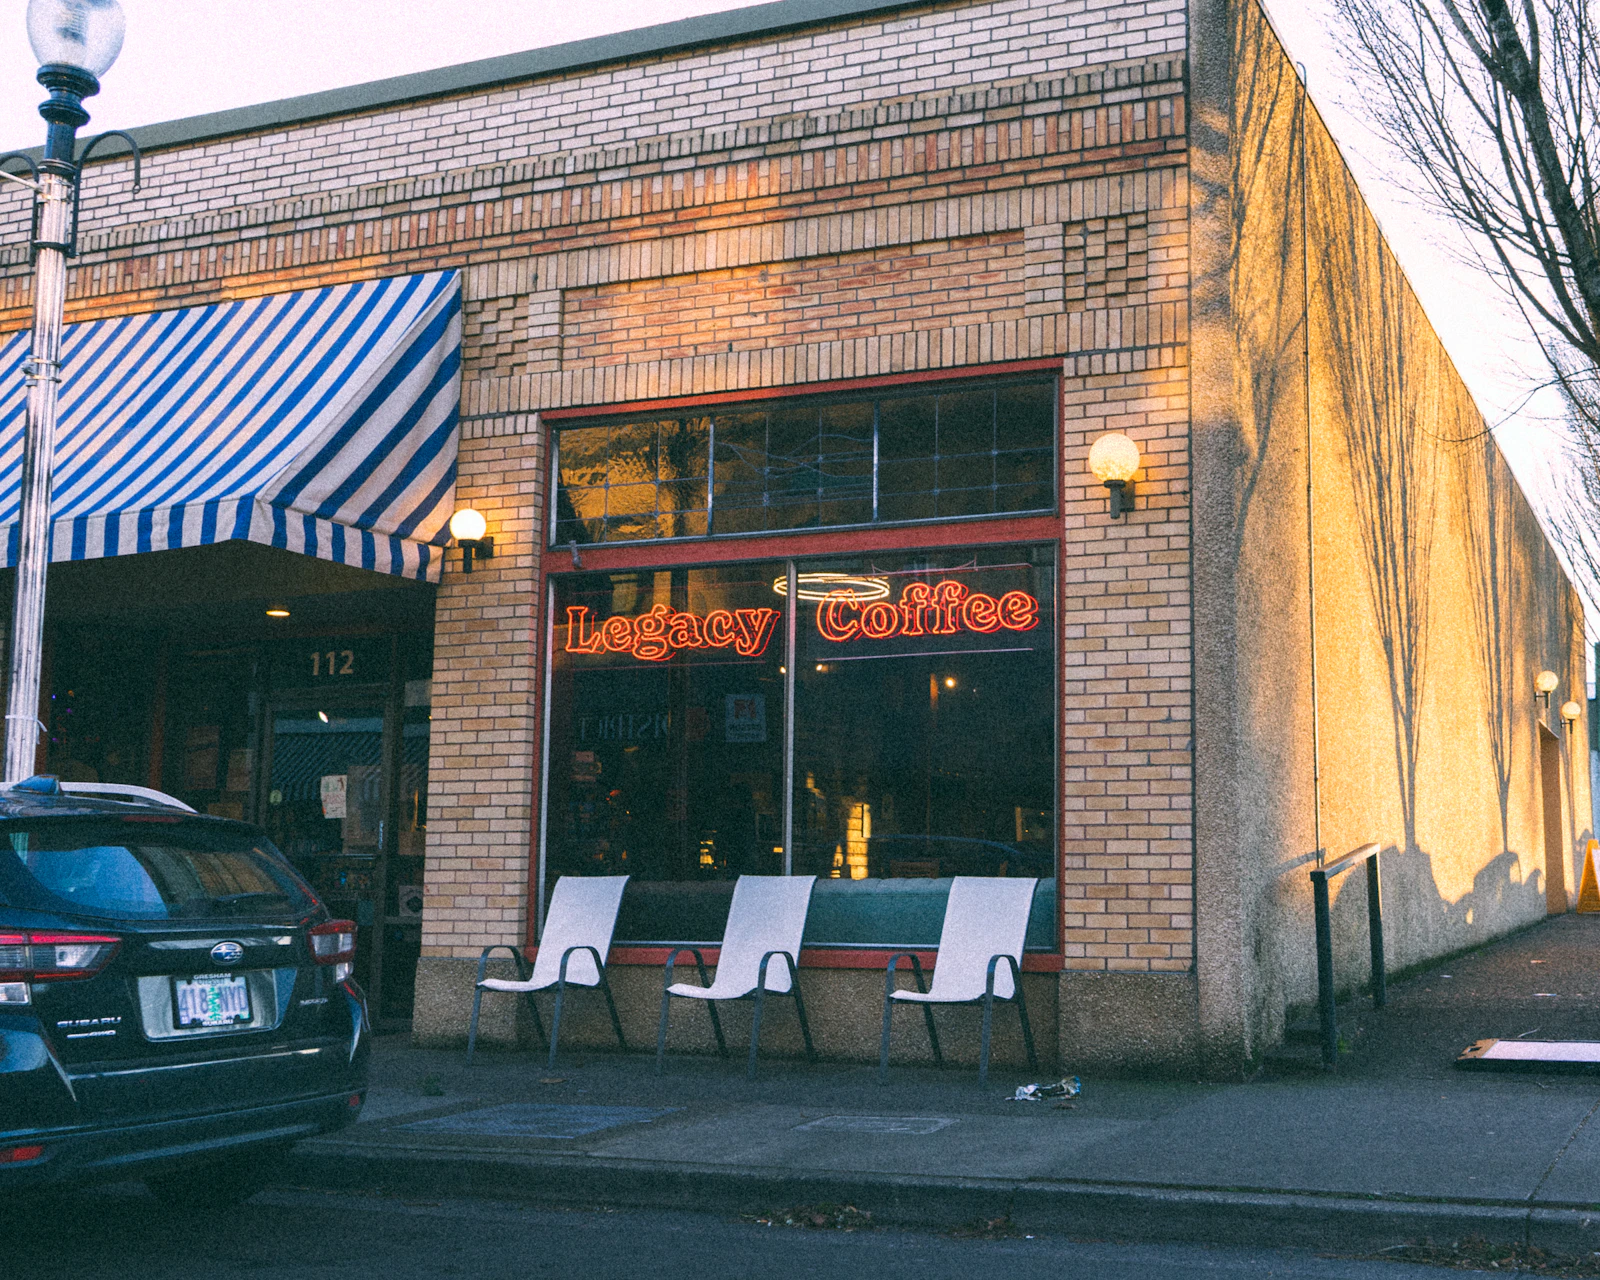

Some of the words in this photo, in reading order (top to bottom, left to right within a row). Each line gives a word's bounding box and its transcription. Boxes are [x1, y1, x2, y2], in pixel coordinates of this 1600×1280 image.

[565, 603, 774, 661] Legacy
[816, 579, 1033, 641] Coffee
[310, 650, 355, 676] 112
[179, 987, 209, 1015] 418
[218, 985, 249, 1013] NYD
[57, 1016, 121, 1027] SUBARU
